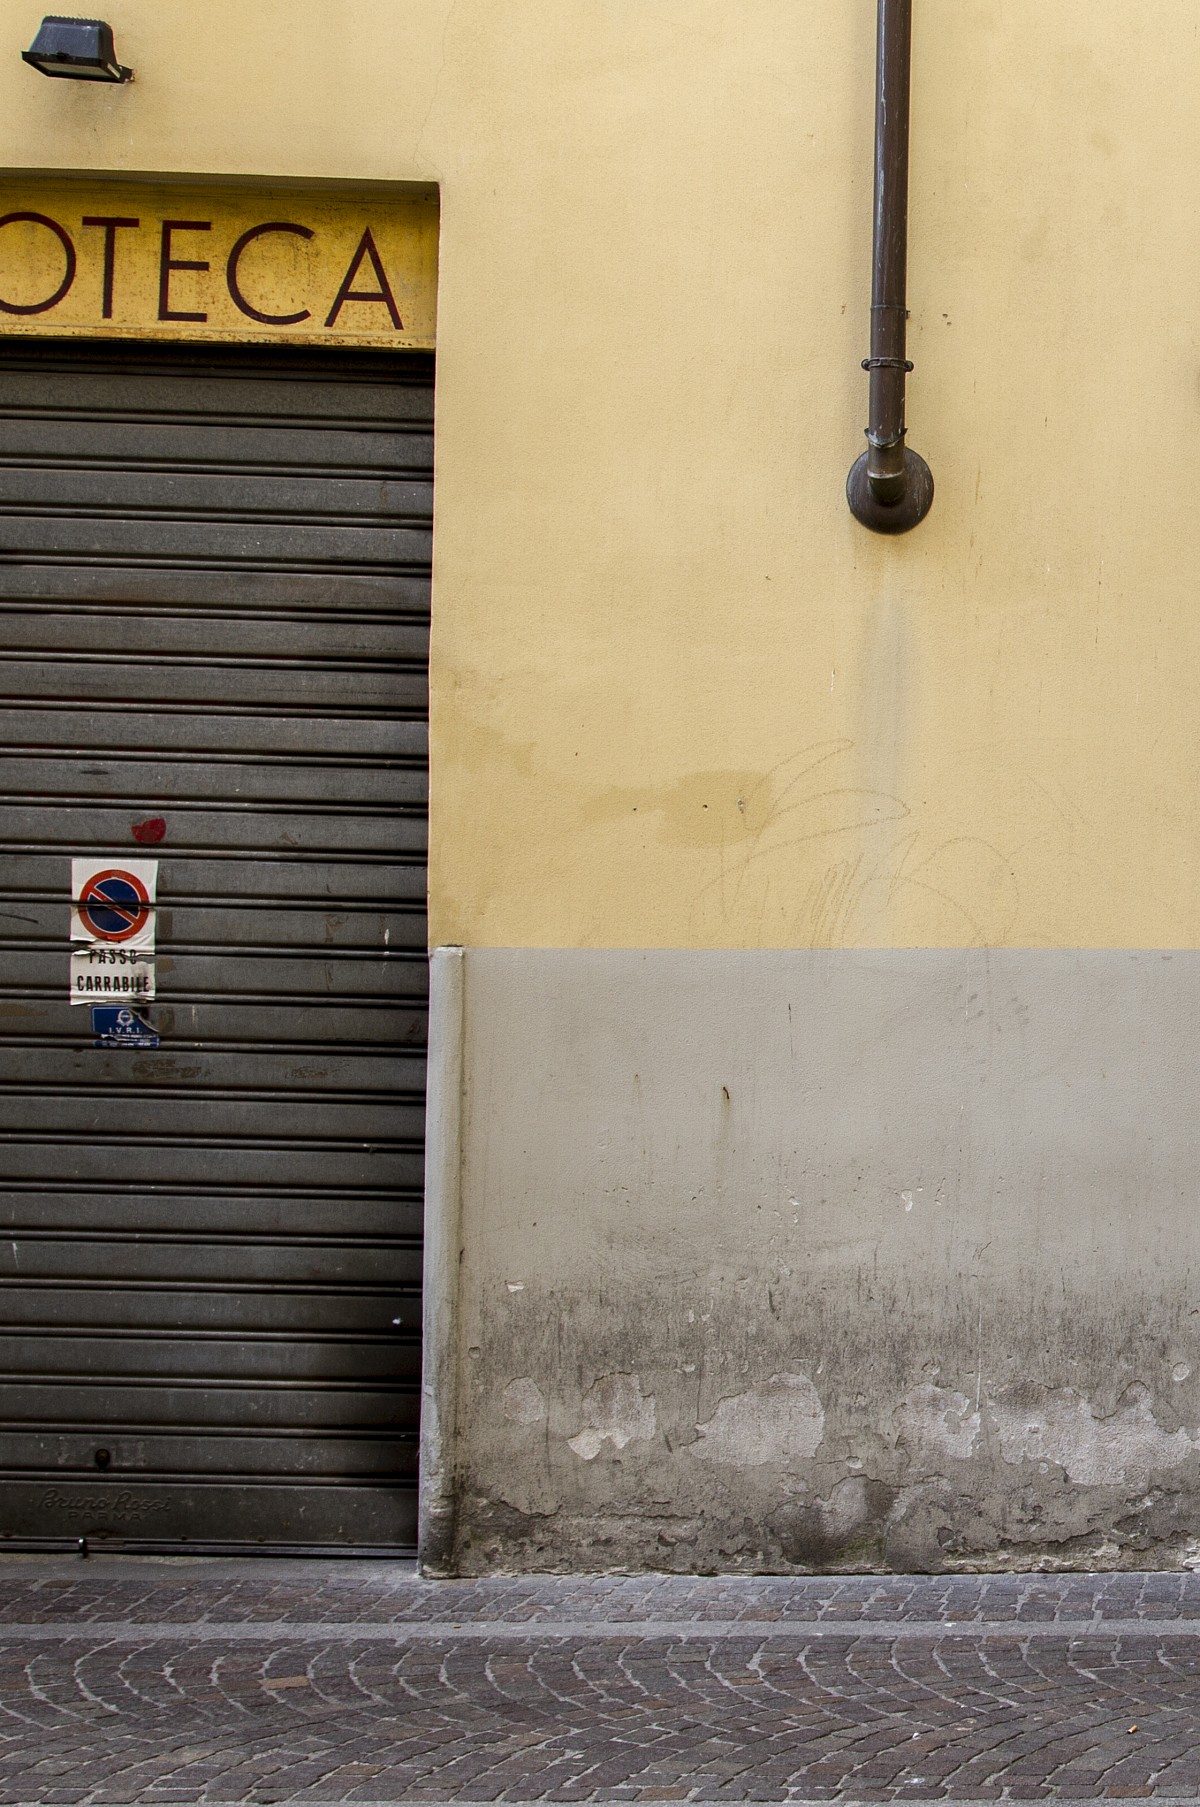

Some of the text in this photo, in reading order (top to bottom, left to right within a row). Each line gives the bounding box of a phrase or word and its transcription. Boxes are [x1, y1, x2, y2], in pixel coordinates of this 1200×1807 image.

[0, 211, 404, 331] OTECA
[89, 949, 138, 965] PASSO
[76, 975, 150, 992] CARRABILE
[39, 1487, 109, 1509] Bruno
[68, 1510, 142, 1522] PARMA
